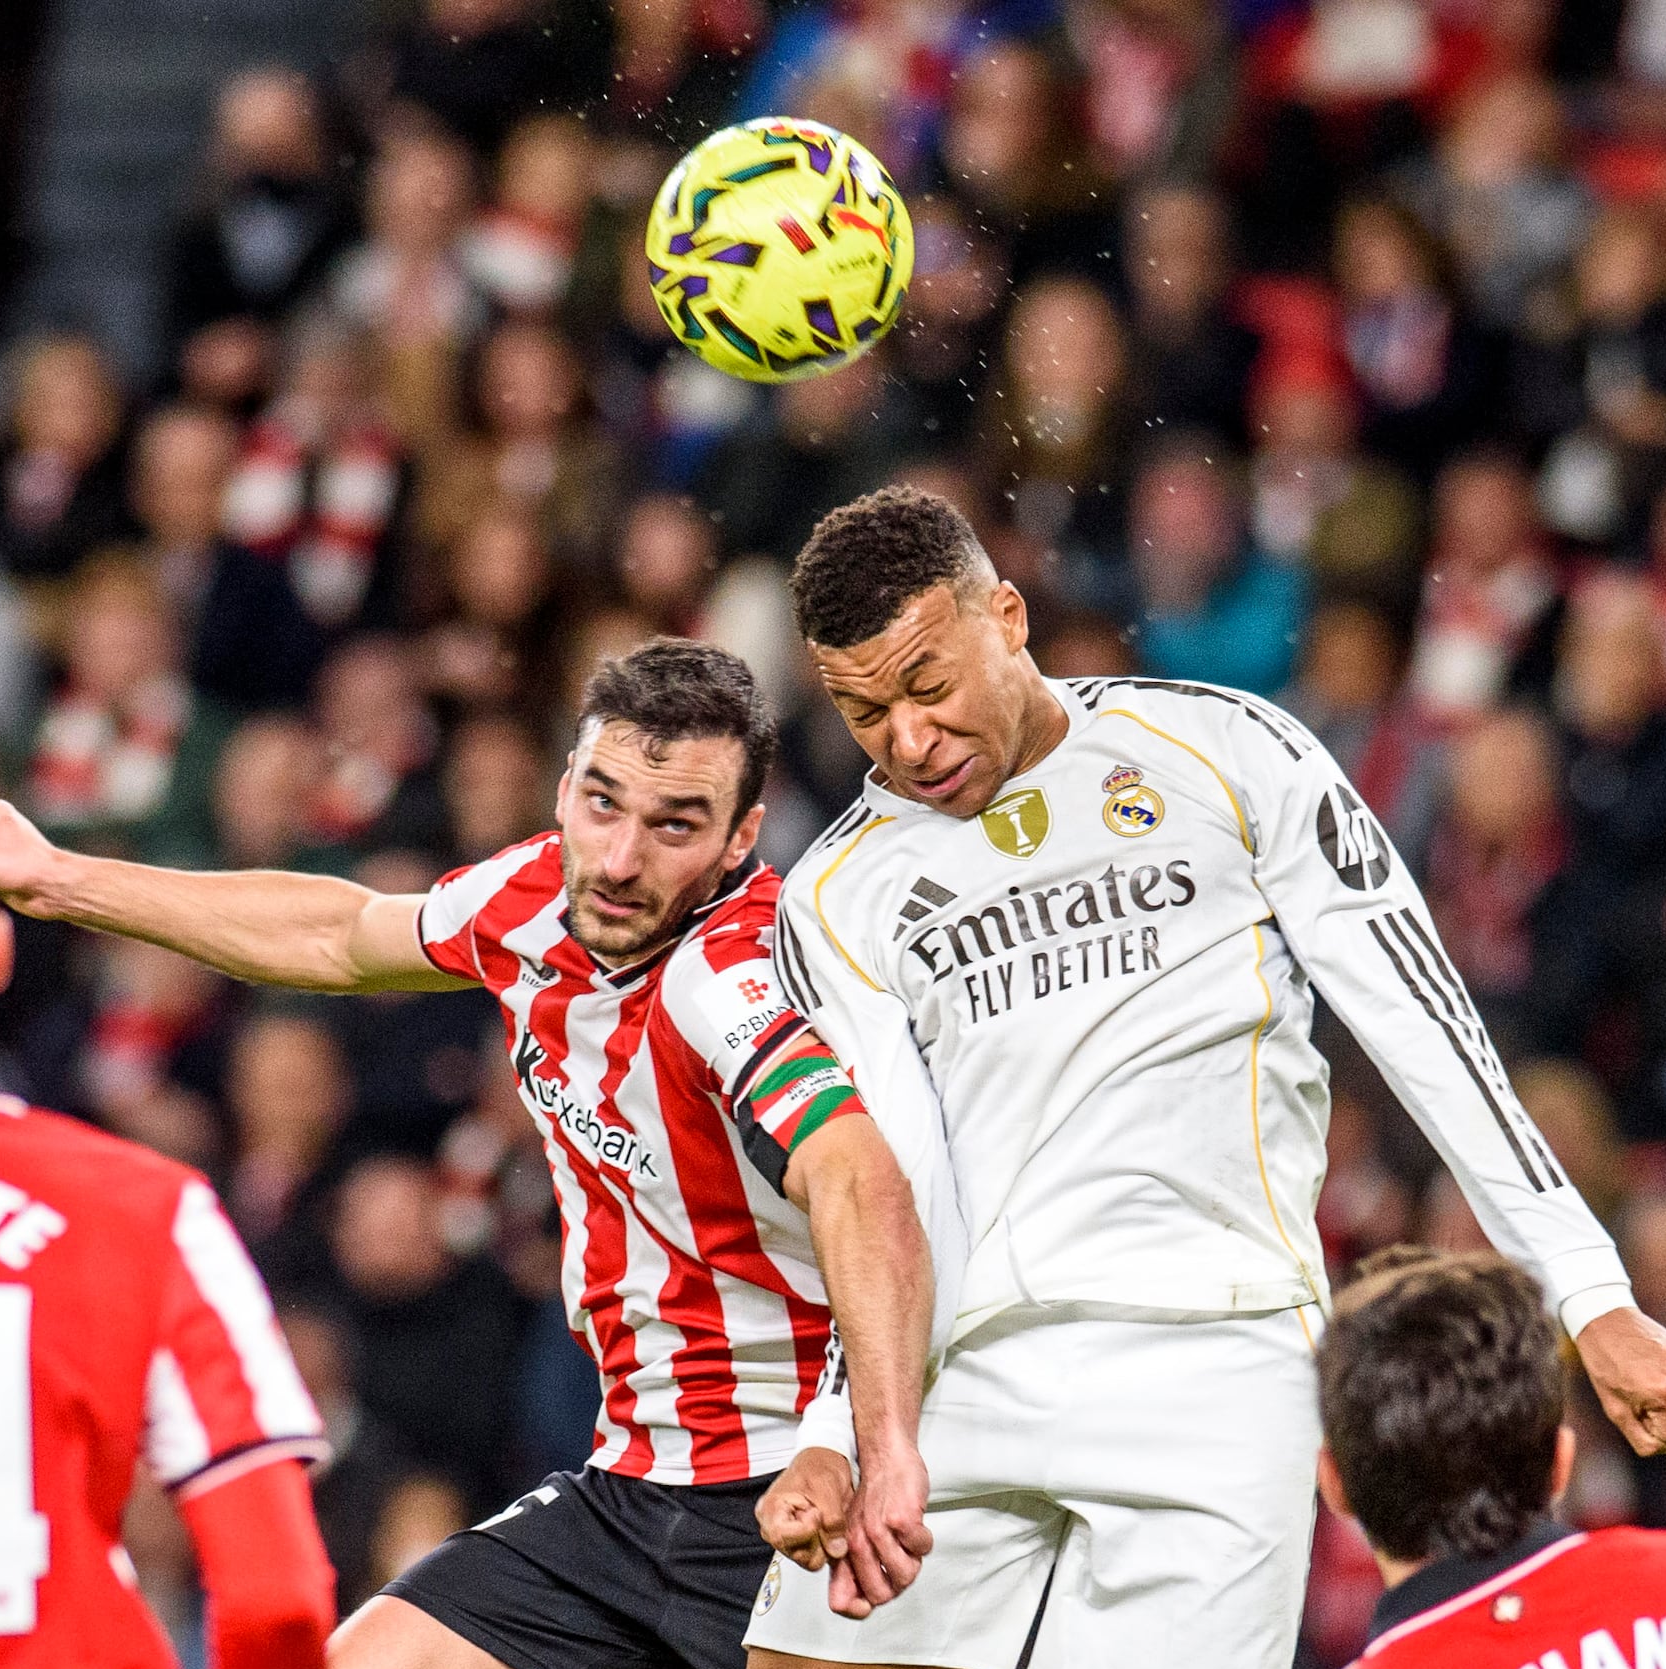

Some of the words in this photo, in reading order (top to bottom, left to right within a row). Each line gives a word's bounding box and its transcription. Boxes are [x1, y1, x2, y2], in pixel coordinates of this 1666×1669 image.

[908, 860, 1196, 984] Emirates
[964, 961, 1013, 1023] FLY
[1032, 926, 1162, 999] BETTER
